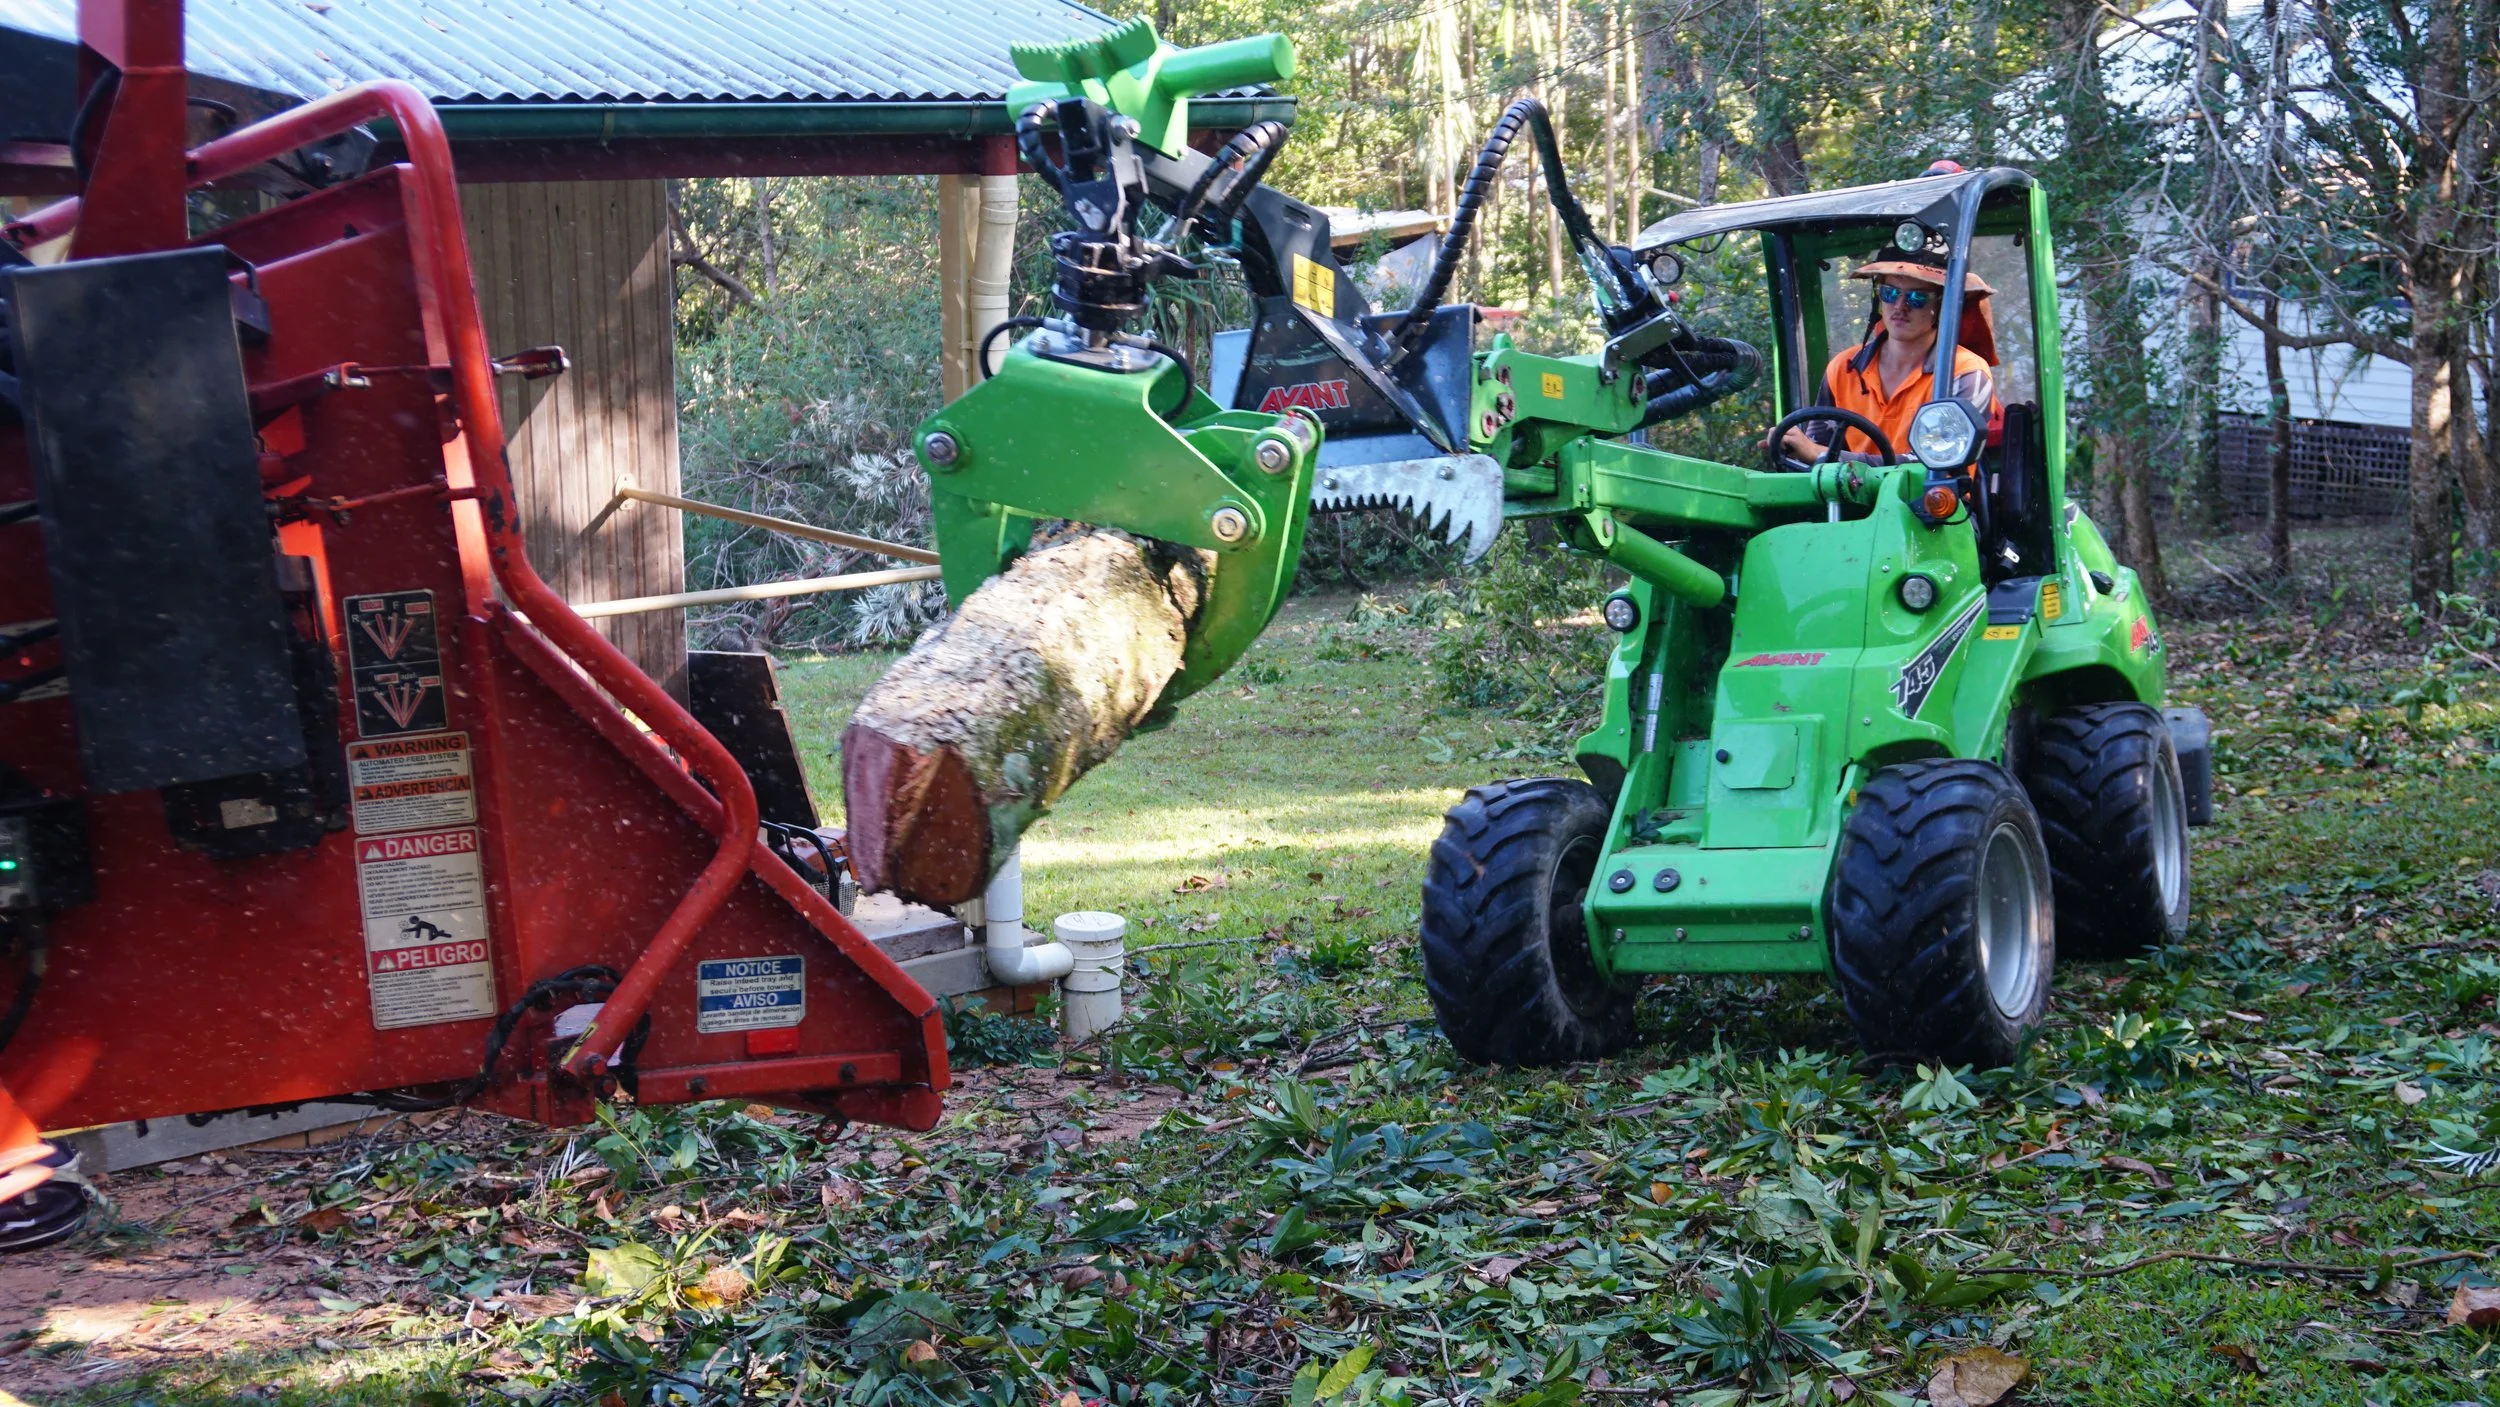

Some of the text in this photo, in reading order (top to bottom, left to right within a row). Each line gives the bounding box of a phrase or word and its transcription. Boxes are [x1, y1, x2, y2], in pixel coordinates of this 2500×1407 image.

[1257, 379, 1350, 413] AVANT
[352, 614, 360, 622] R
[1732, 652, 1827, 668] AVANT
[1889, 653, 1935, 707] 745
[375, 737, 461, 755] WARNING
[358, 755, 405, 767] AUTOMATED
[406, 754, 426, 763] FEED
[375, 779, 467, 798] ADVERTENCIA
[385, 832, 474, 857] DANGER
[396, 943, 484, 968] PELIGRO
[725, 961, 782, 976] NOTICE
[761, 975, 777, 983] tray
[710, 987, 737, 995] secure
[739, 985, 765, 993] before
[733, 993, 778, 1008] AVISO
